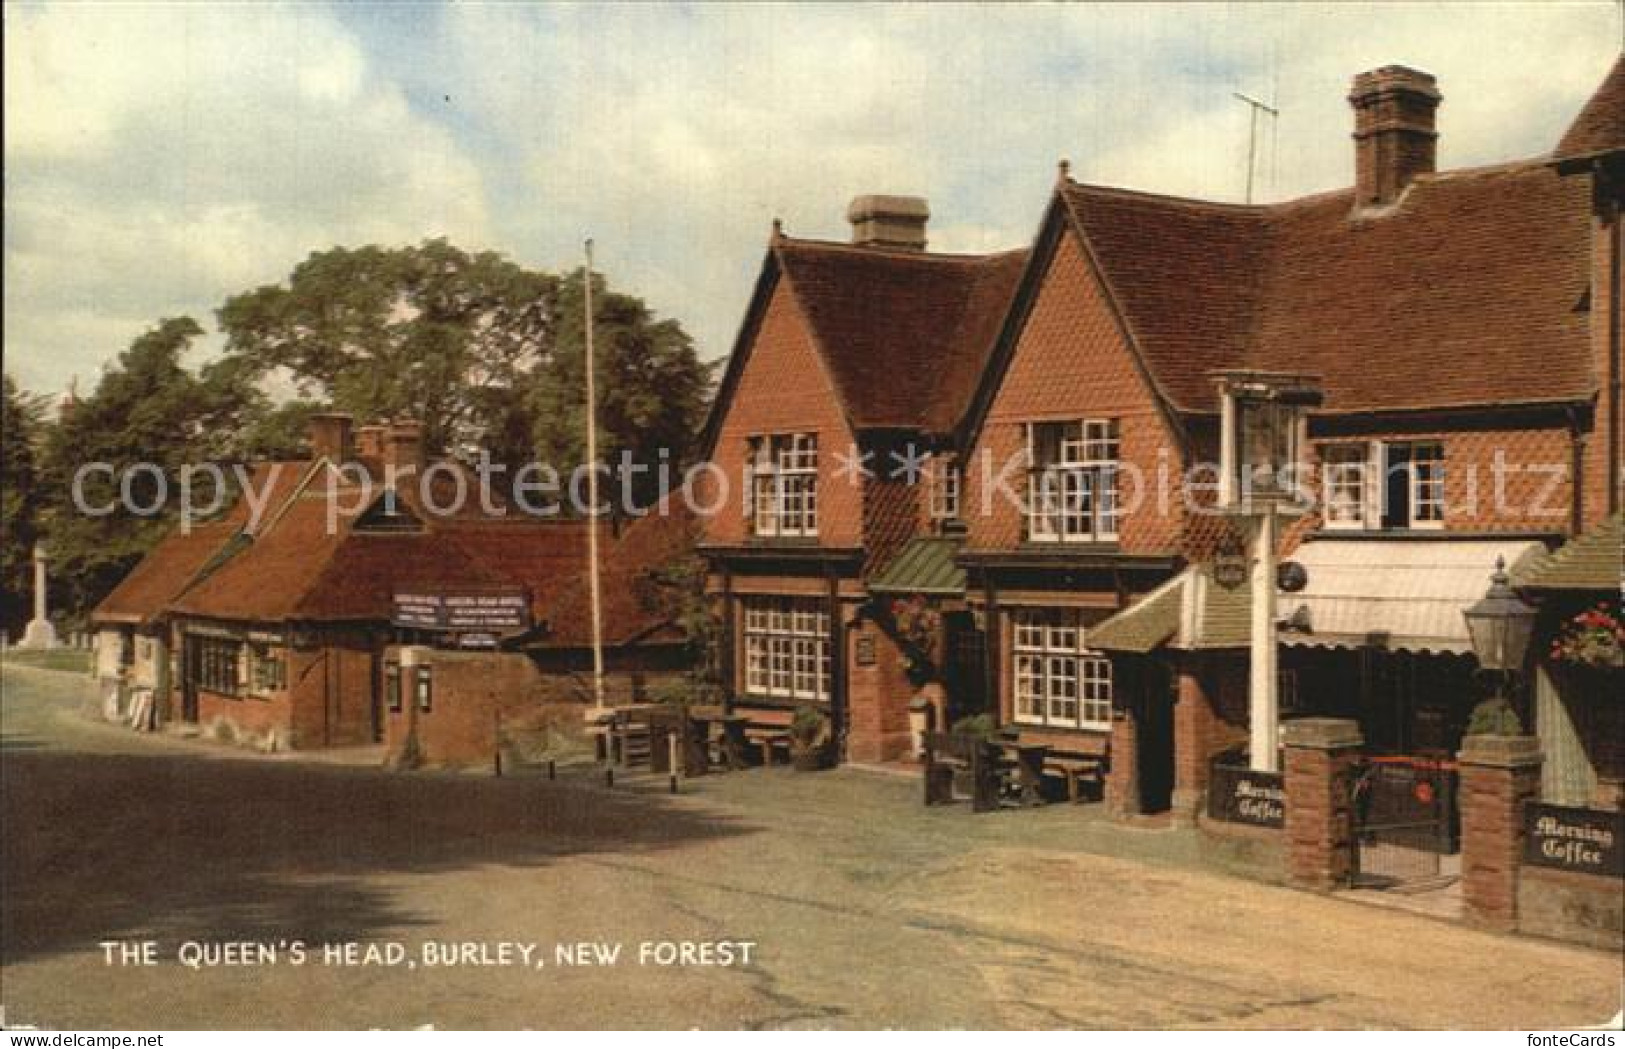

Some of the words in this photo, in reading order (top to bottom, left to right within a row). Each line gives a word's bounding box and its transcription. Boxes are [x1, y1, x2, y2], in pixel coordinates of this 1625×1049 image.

[1235, 780, 1284, 799] Mornin
[1534, 816, 1613, 848] Morning
[1542, 839, 1602, 864] Coffee
